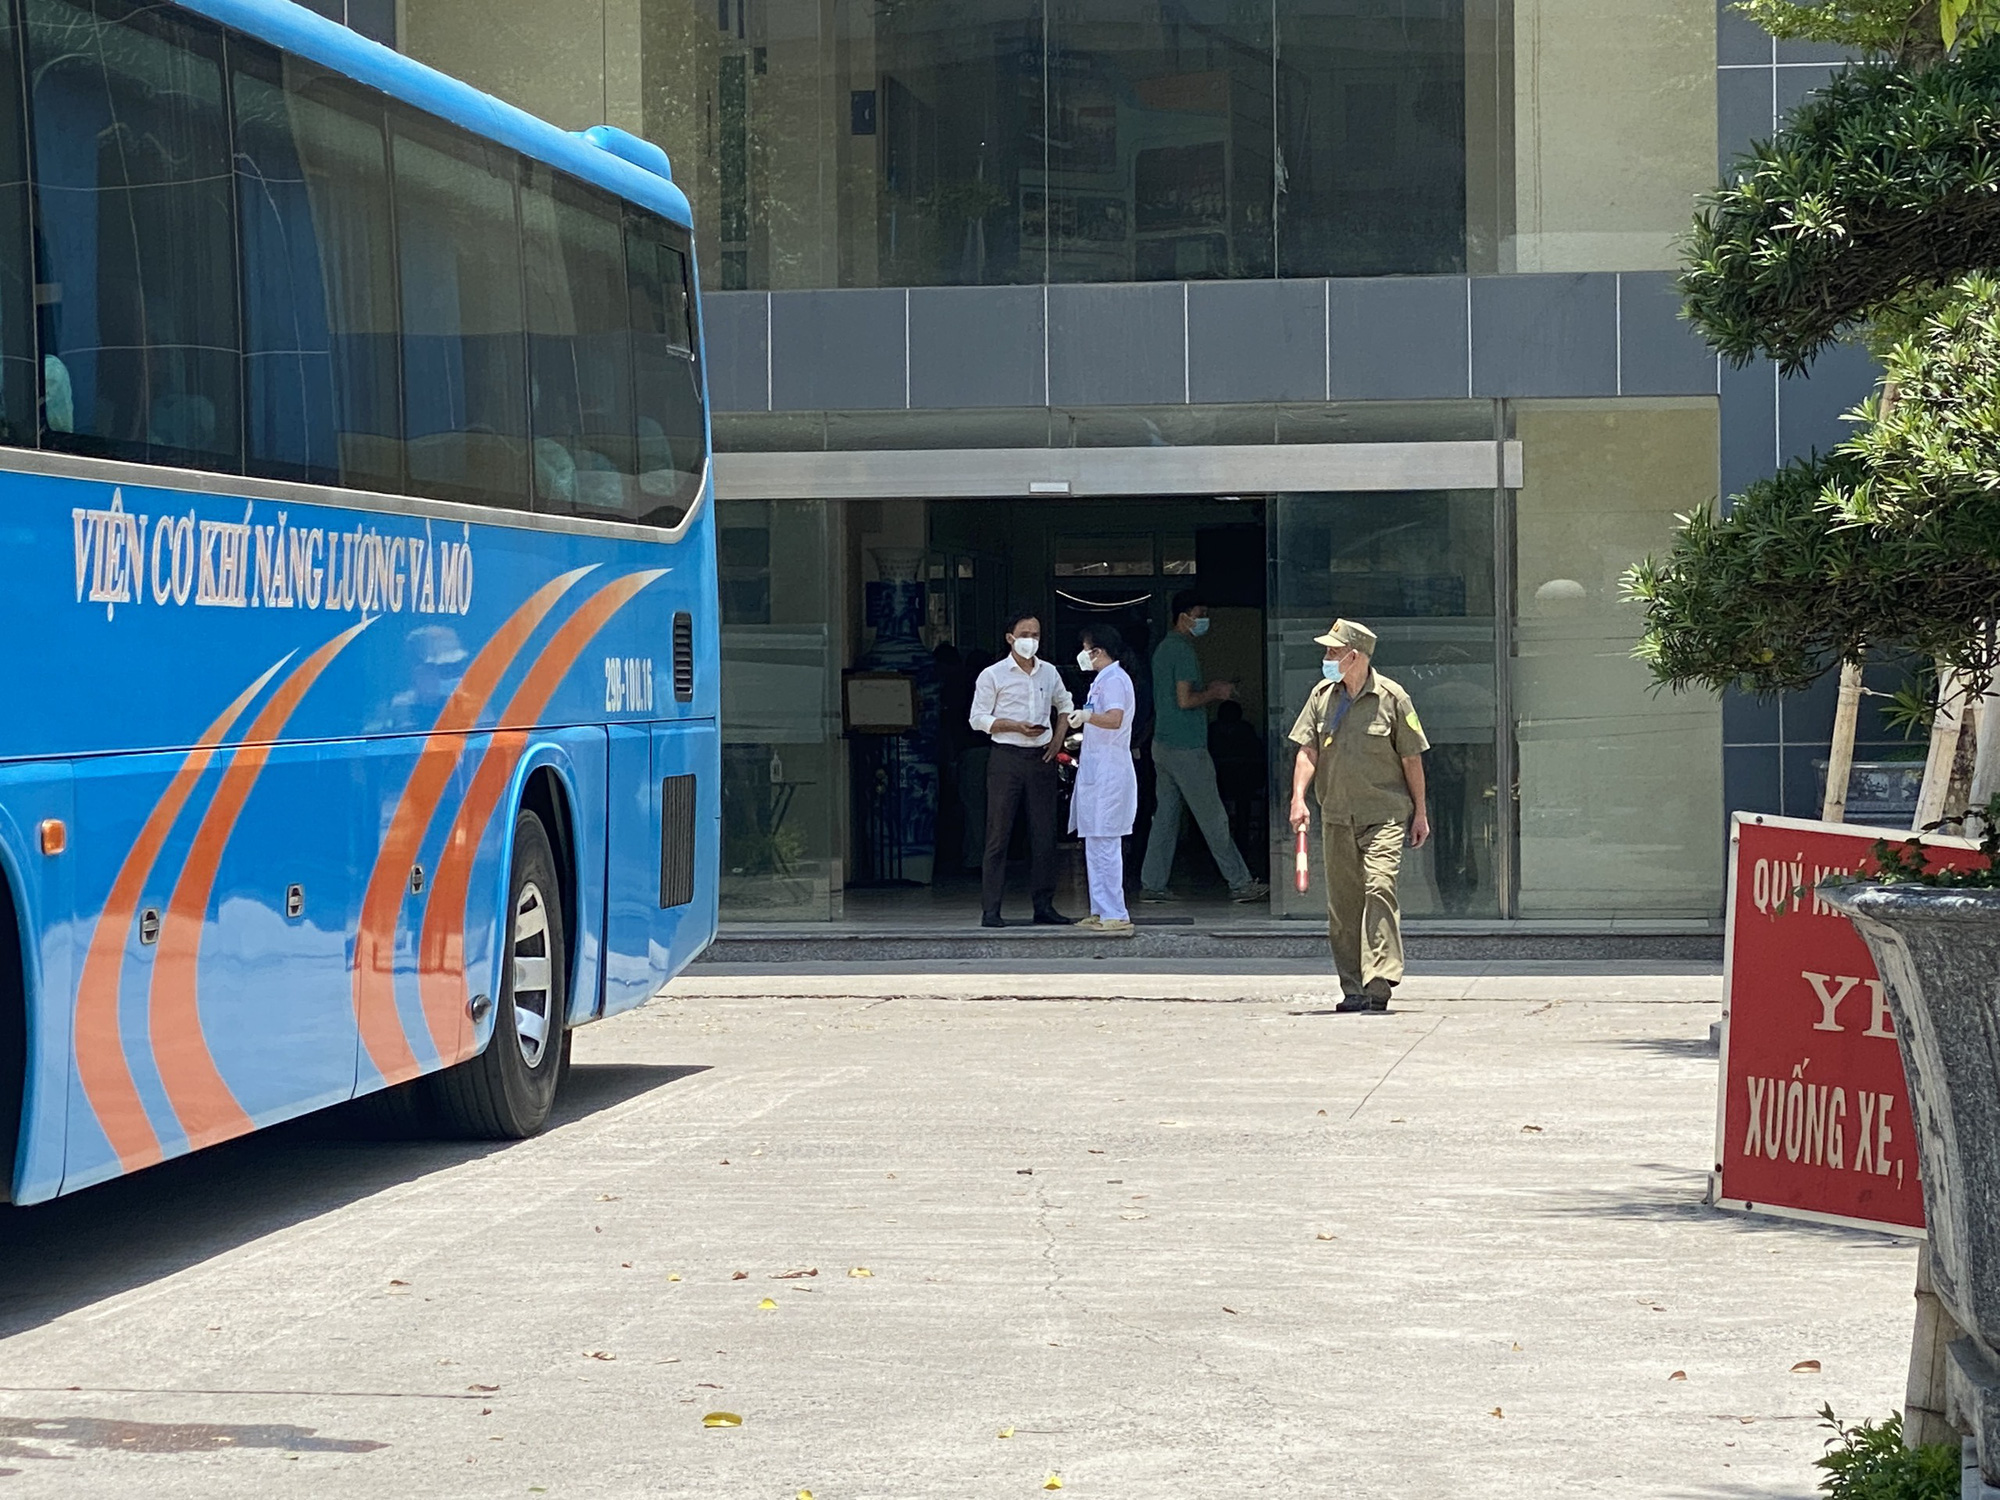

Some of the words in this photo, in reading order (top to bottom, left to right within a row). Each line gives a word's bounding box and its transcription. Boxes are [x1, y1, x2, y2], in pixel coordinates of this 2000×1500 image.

[72, 487, 148, 622] VIỆN
[152, 508, 195, 606] CƠ
[195, 500, 254, 608] KHÍ
[251, 511, 324, 610] NĂNG
[325, 523, 406, 625] LƯỢNG
[409, 518, 435, 613] VÀ
[438, 522, 473, 615] MỎ
[605, 657, 653, 712] 29B-100.16
[1753, 852, 1803, 916] QUÝ
[1743, 1057, 1847, 1170] XUỐNG
[1853, 1090, 1904, 1190] XE,
